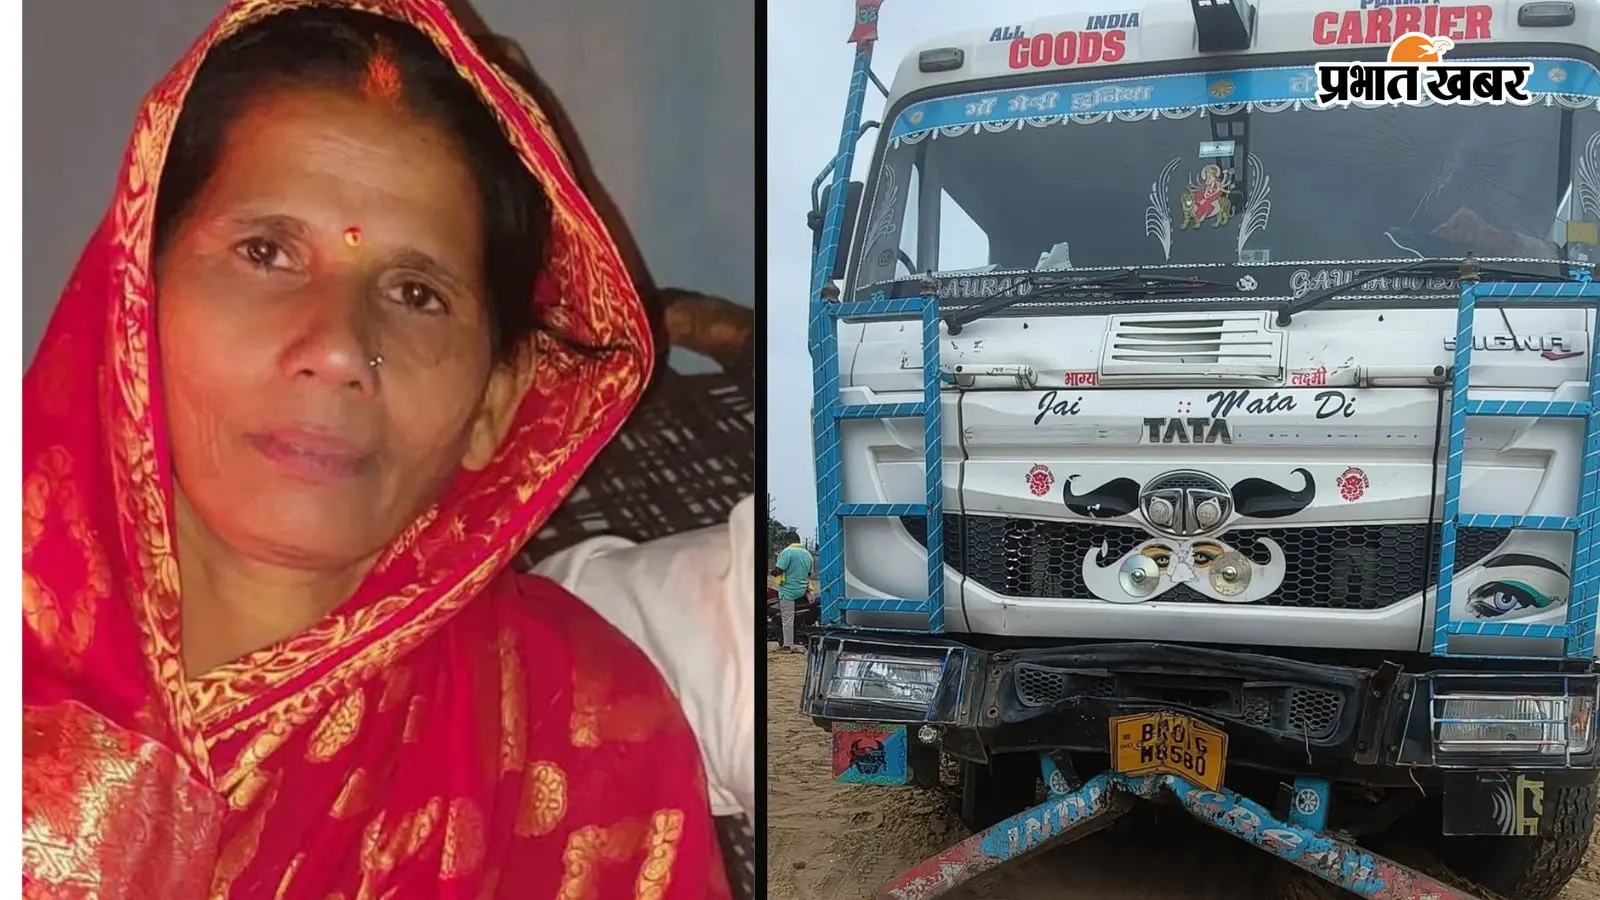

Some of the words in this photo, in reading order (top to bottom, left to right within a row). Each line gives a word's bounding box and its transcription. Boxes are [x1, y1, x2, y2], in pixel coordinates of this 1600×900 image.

[990, 25, 1025, 42] ALL
[1086, 12, 1140, 30] INDIA
[1312, 5, 1493, 45] CARRIER
[1008, 30, 1126, 69] GOODS
[1034, 390, 1083, 425] Jai
[1206, 390, 1297, 418] Mata
[1314, 391, 1356, 420] Di
[1143, 417, 1232, 444] TATA
